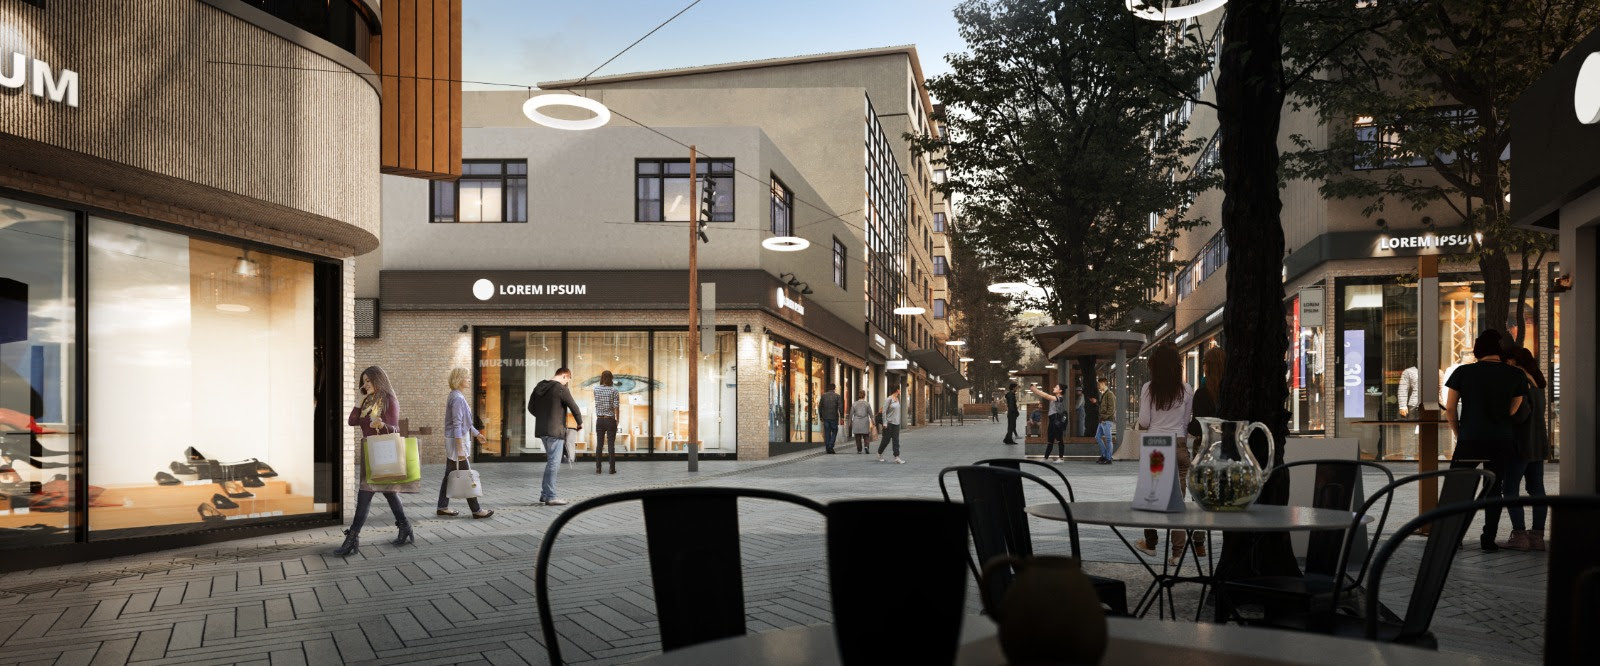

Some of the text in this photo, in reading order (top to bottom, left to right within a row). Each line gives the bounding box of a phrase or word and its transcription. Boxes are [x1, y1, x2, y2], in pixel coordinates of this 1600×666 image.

[1380, 235, 1431, 249] LOREM
[499, 284, 587, 295] LOREM IPSUM
[1147, 436, 1167, 445] drinks
